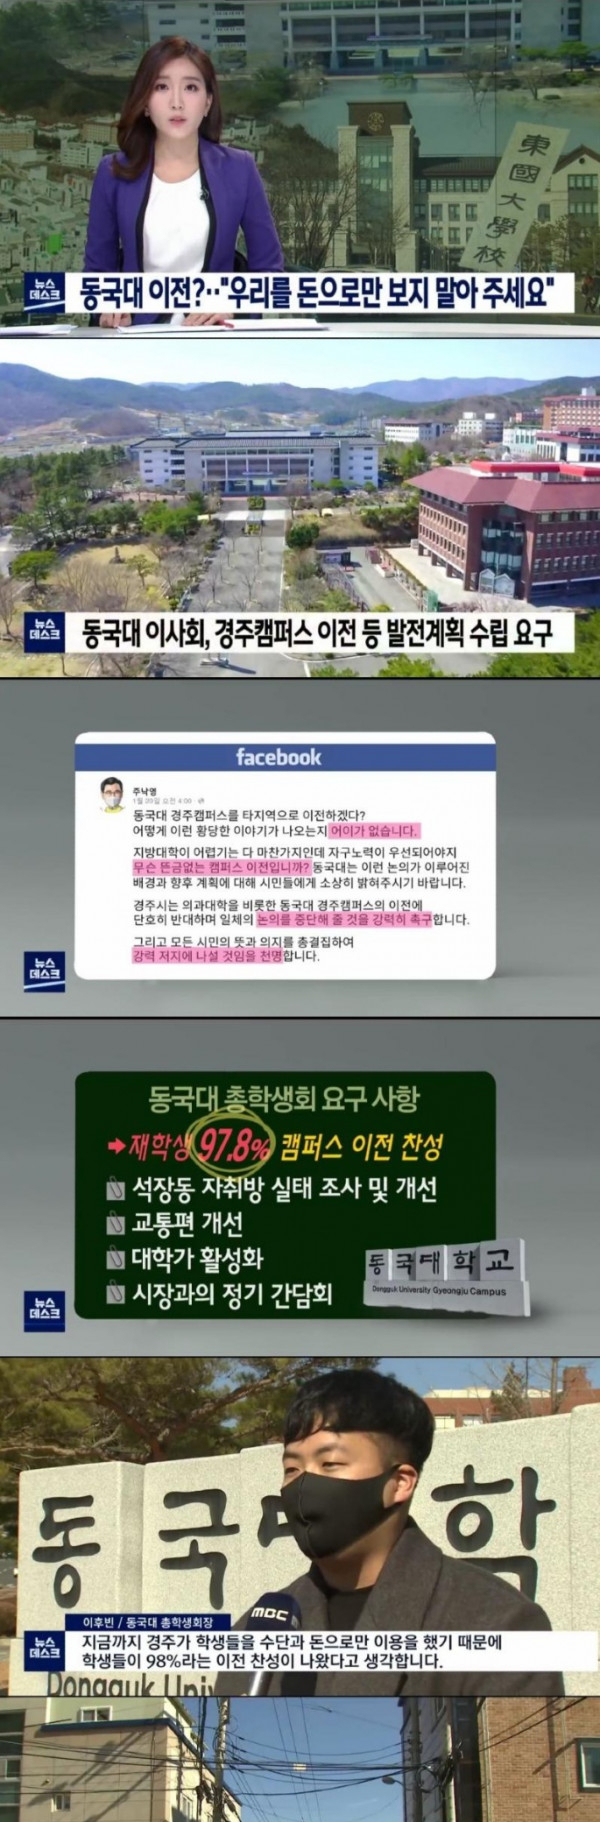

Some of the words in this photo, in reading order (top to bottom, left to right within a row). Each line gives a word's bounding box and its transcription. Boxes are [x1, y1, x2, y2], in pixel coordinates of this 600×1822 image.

[473, 134, 551, 267] 東國大學校
[369, 1249, 514, 1275] 동국대학교
[399, 1286, 431, 1295] University
[433, 1286, 469, 1296] Gyeongju
[470, 1287, 507, 1297] Campus
[251, 1607, 288, 1621] MBC
